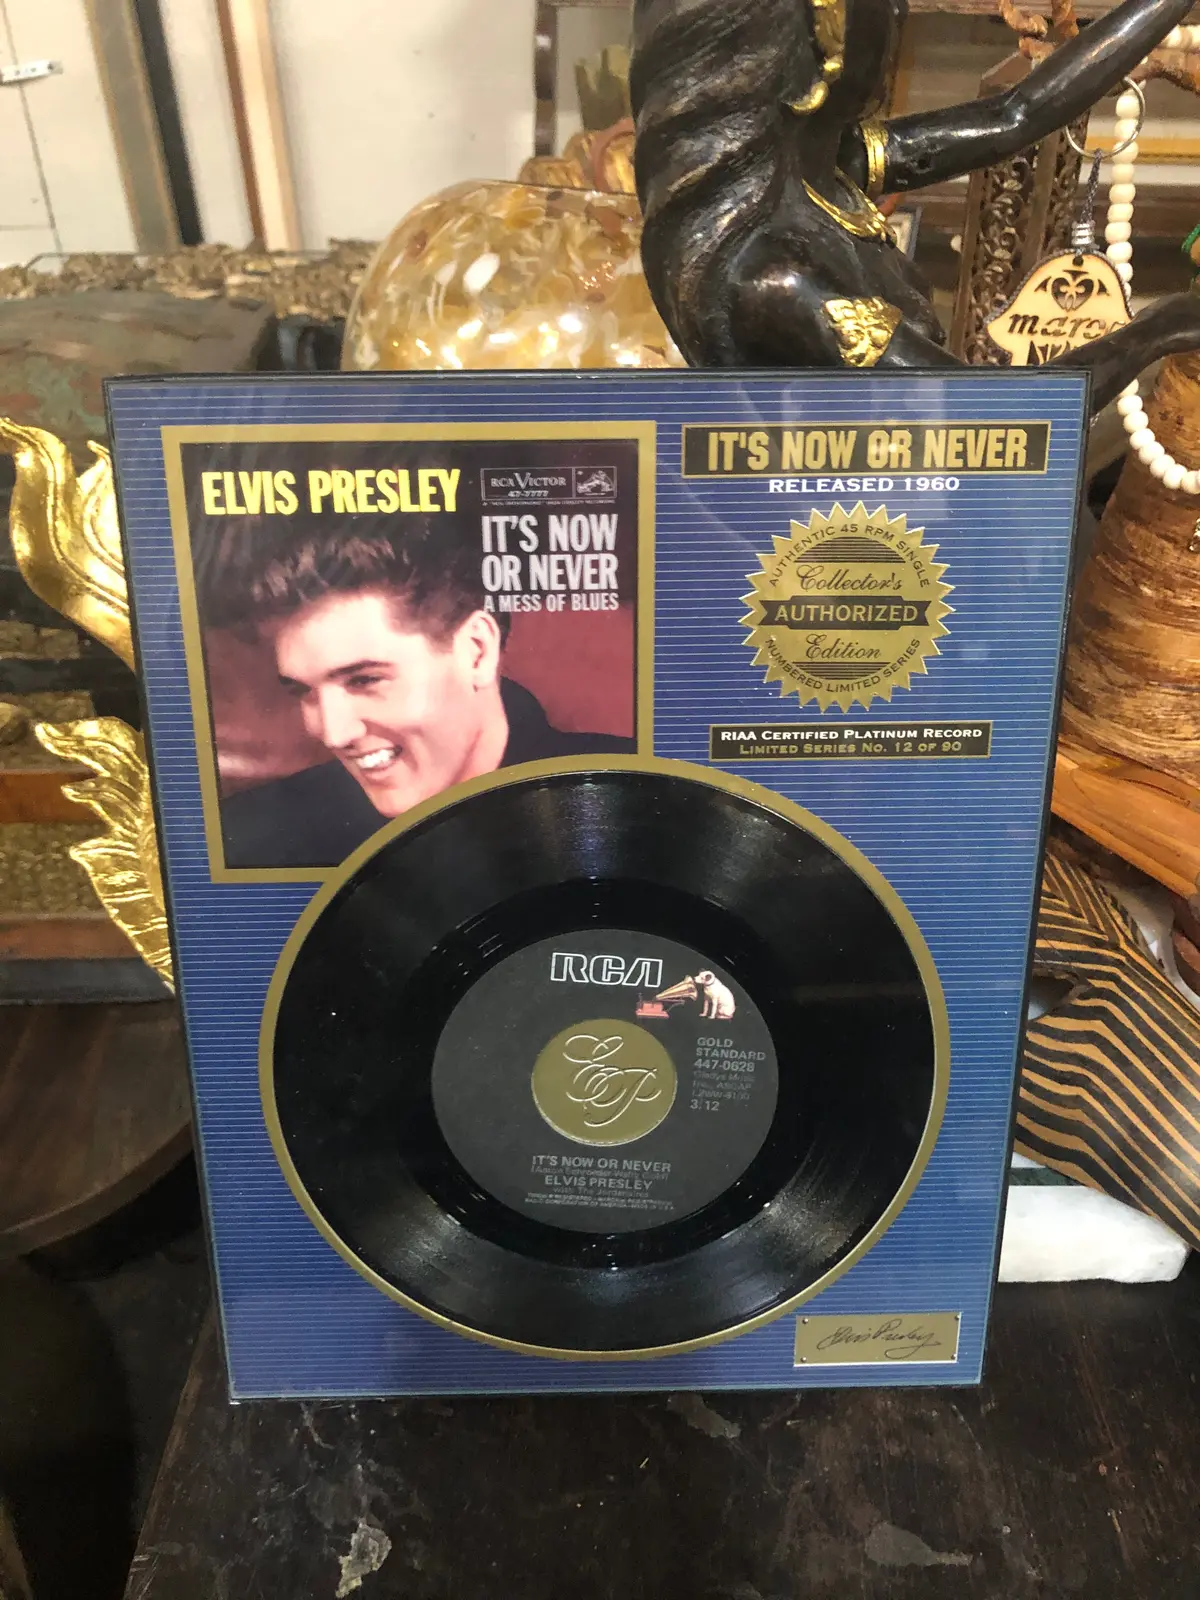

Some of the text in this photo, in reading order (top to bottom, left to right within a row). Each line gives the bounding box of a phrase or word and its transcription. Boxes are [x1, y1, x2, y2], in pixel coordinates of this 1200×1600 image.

[708, 428, 1028, 471] IT'S NOW OR NEVER
[490, 477, 516, 487] RCA
[768, 476, 960, 494] RELEASED 1960
[202, 468, 461, 515] ELVIS PRESLEY
[482, 514, 619, 552] IT'S NOW
[769, 523, 931, 589] AUTHENTIC 45 RPM SINGLE
[482, 553, 619, 592] OR NEVER
[796, 564, 903, 591] Collector's
[483, 593, 619, 612] A MESS OF BLUES
[774, 604, 918, 622] AUTHORIZED
[805, 633, 882, 660] Edition
[765, 638, 921, 693] NUMBERED LIMITED SERIES
[721, 731, 757, 741] RIAA
[894, 741, 913, 753] 12
[550, 952, 663, 988] RCA
[697, 1037, 733, 1048] GOLD
[696, 1047, 767, 1061] STANDARD
[694, 1058, 756, 1073] 447-0628
[532, 1155, 558, 1166] IT'S
[561, 1156, 593, 1168] NOW
[597, 1157, 618, 1169] OR
[622, 1159, 672, 1173] NEVER
[544, 1175, 653, 1190] ELVIS PRESLEY
